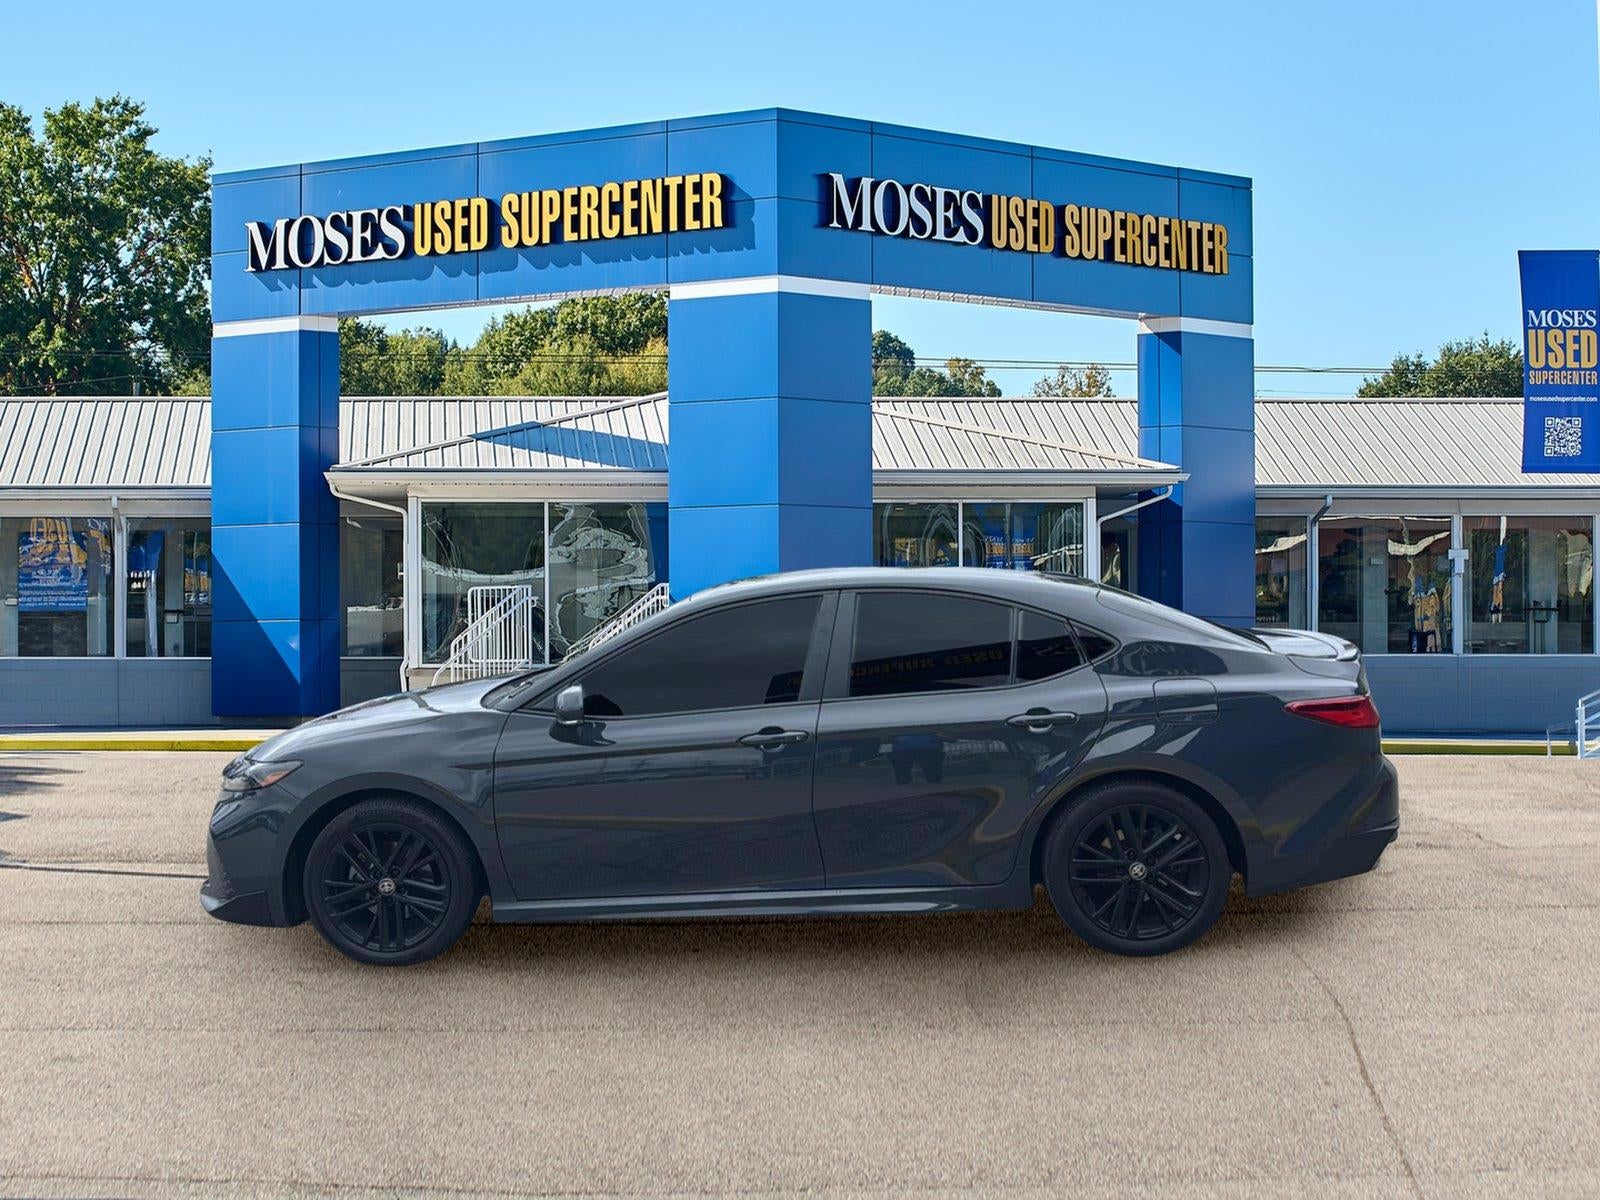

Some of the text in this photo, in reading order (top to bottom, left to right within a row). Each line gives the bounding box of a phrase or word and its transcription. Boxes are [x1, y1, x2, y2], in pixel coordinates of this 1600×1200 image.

[244, 172, 724, 272] MOSES USED SUPERCENTER
[828, 172, 1229, 275] MOSES USED SUPERCENTER
[1527, 309, 1597, 328] MOSES
[1528, 329, 1598, 369] USED
[1529, 370, 1598, 385] SUPERCENTER
